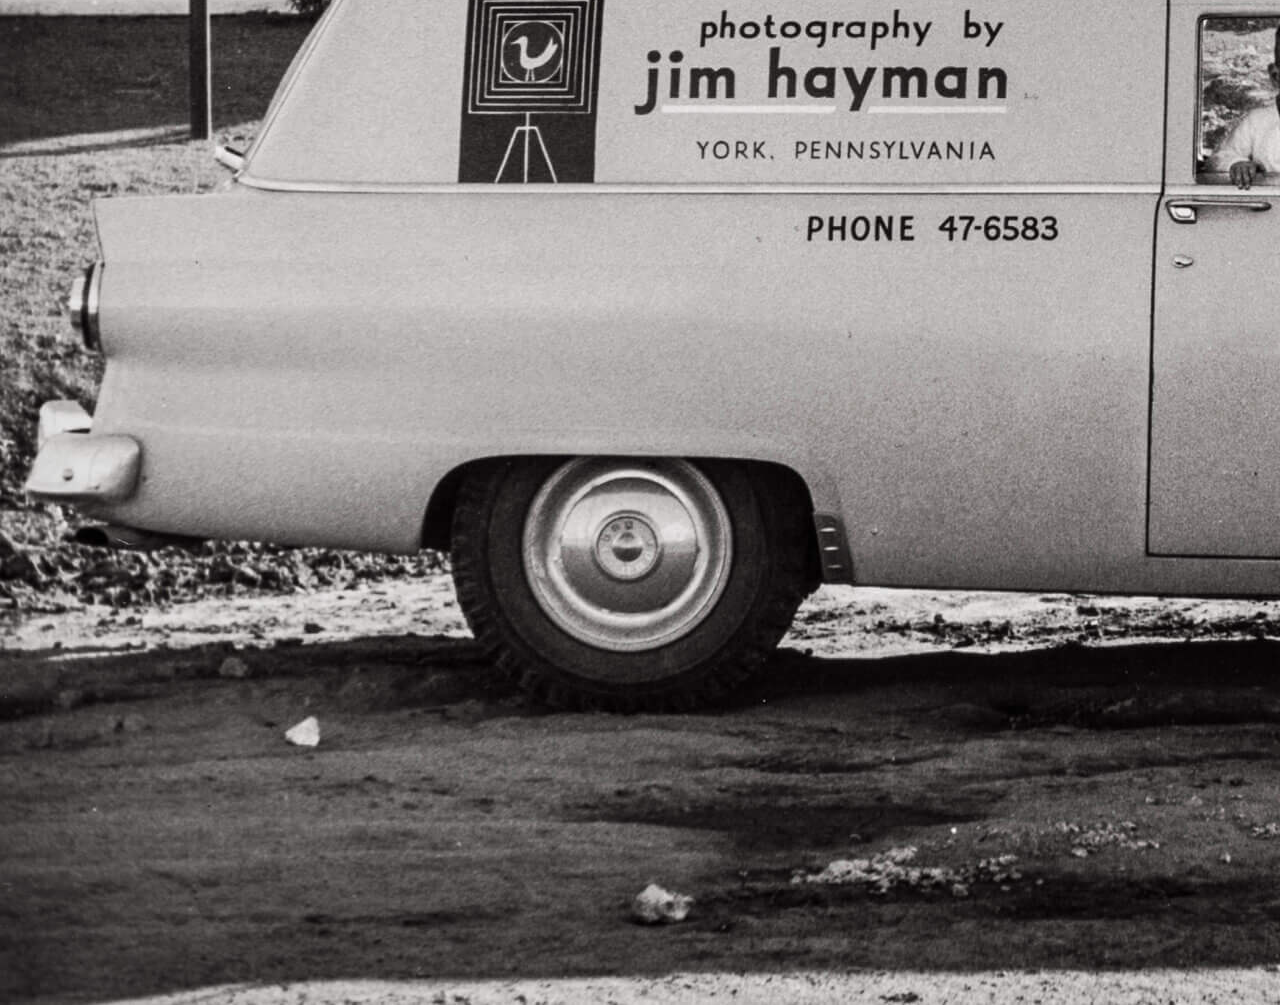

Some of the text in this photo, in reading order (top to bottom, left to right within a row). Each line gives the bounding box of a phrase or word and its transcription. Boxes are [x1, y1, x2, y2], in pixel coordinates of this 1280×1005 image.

[700, 9, 1005, 50] photography by
[634, 46, 1009, 115] jim hayman
[794, 140, 996, 161] PENNSYLVANIA
[806, 215, 1059, 242] PHONE 47-6583
